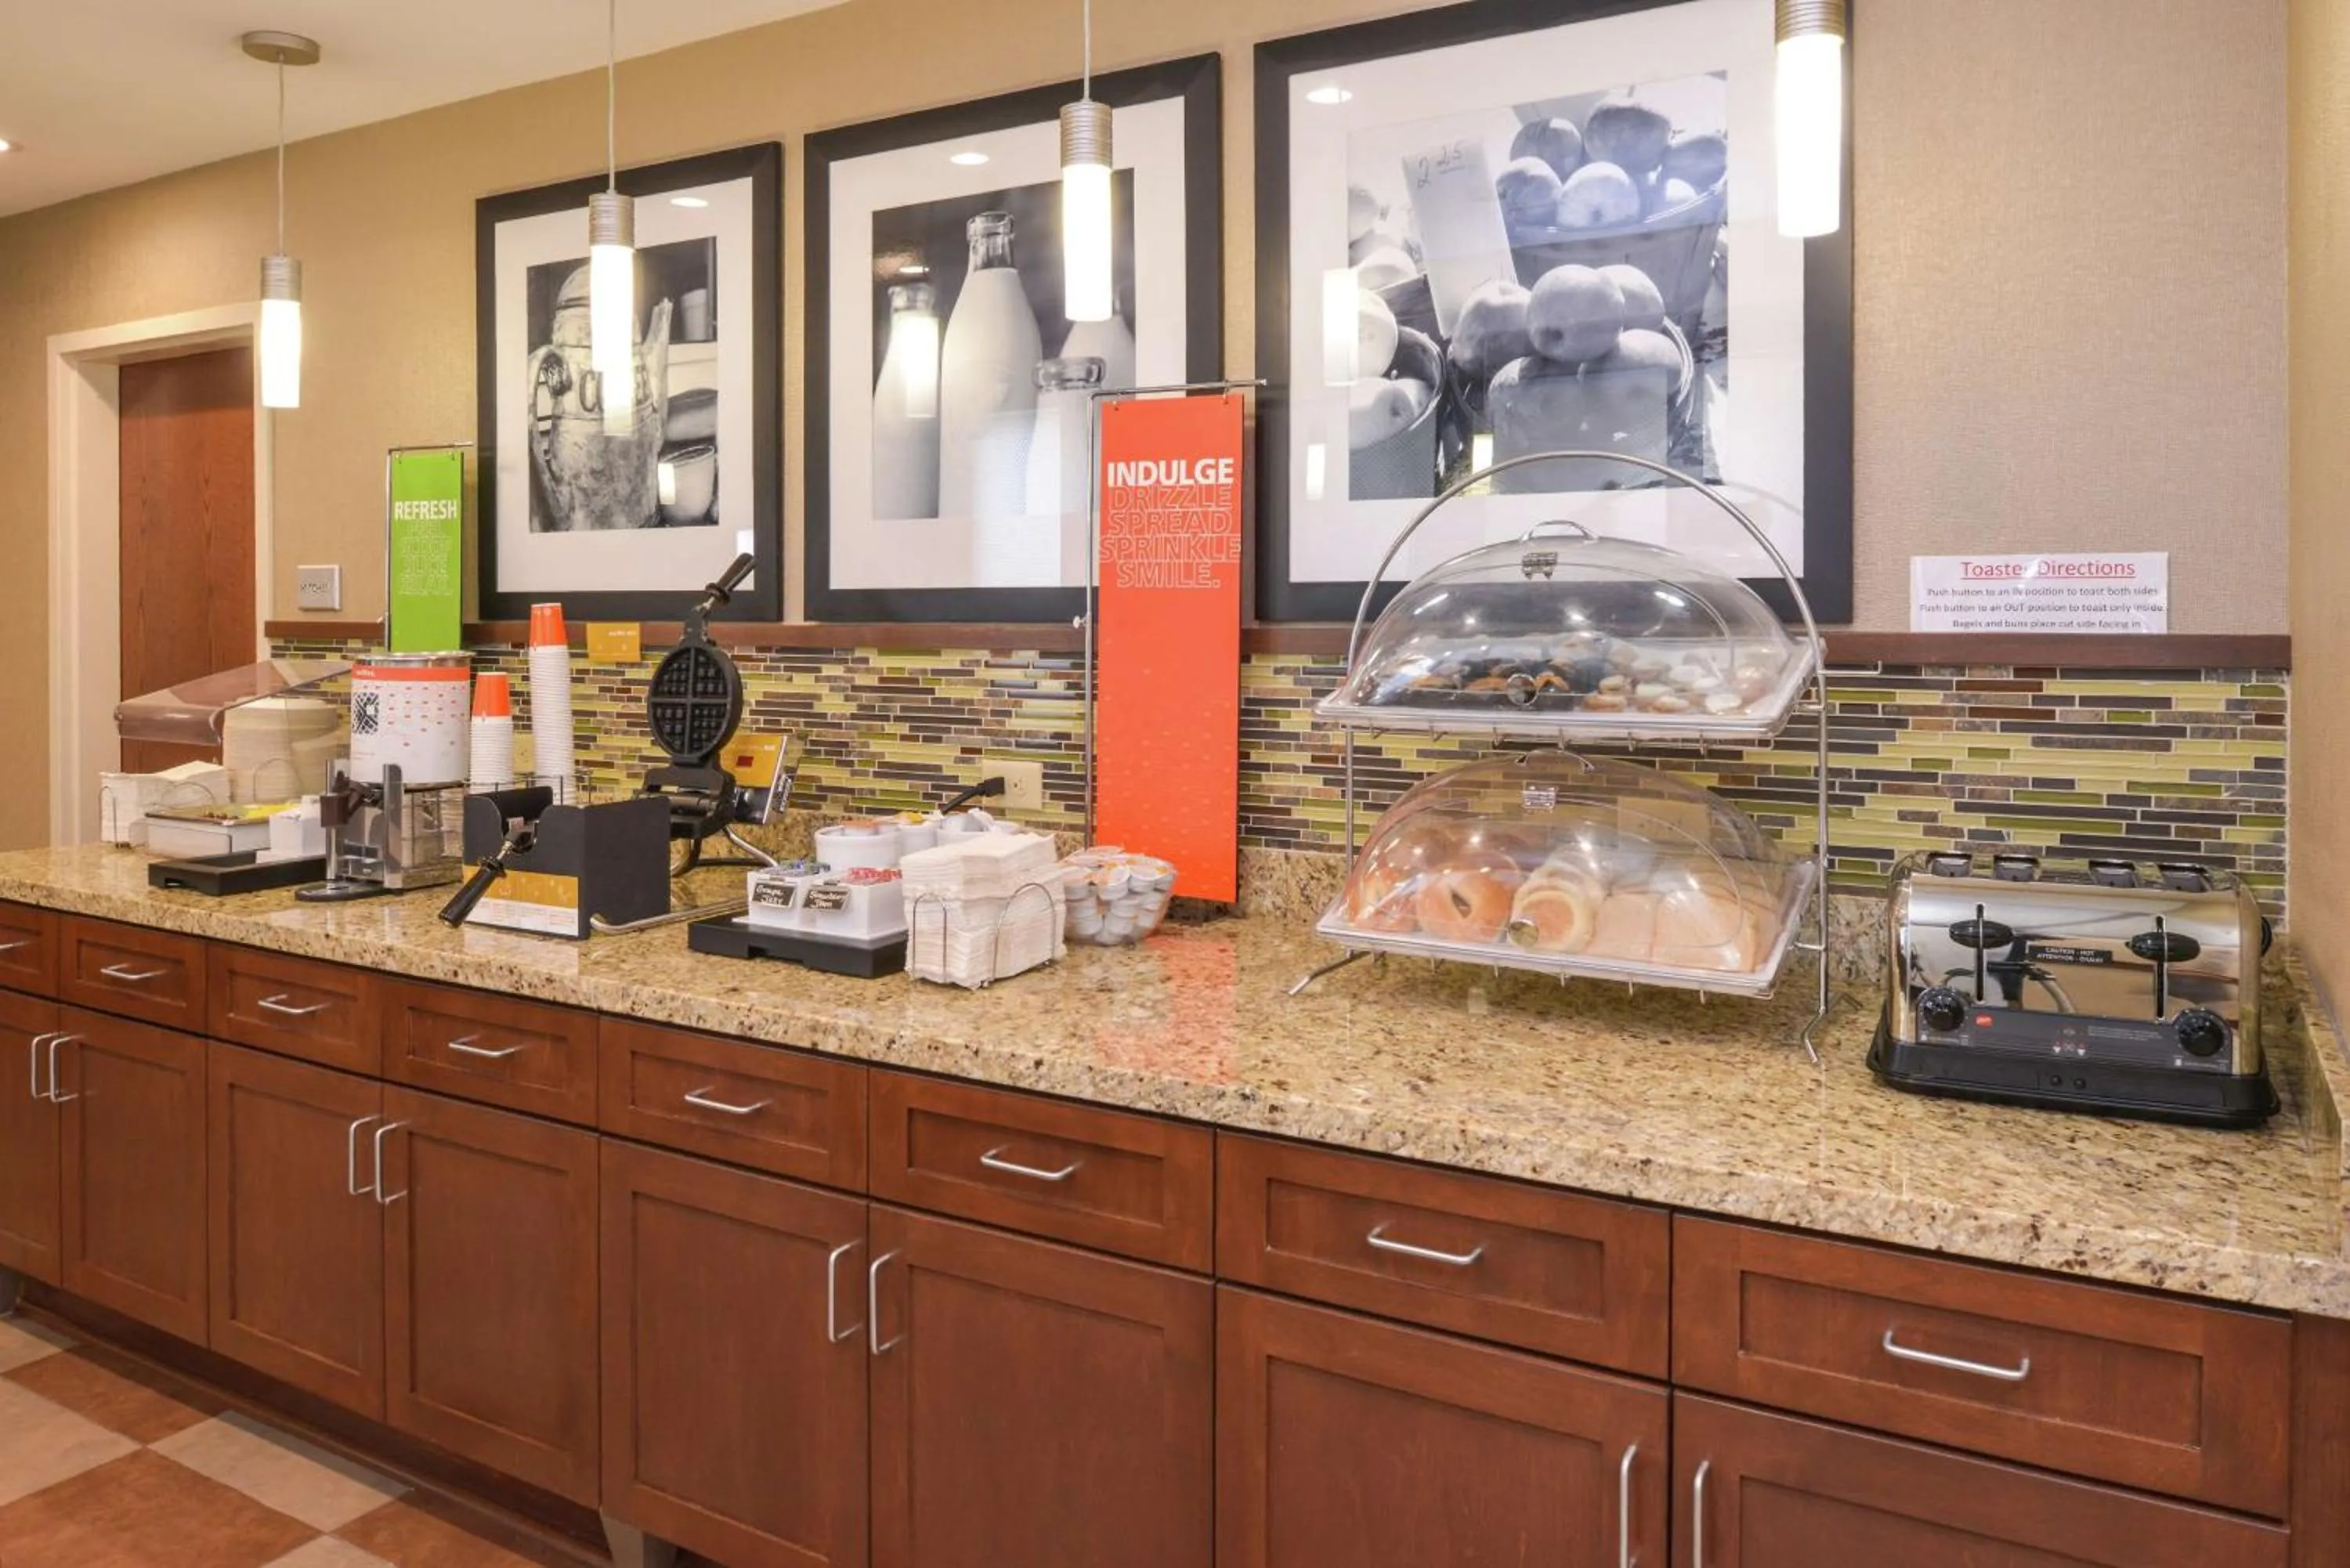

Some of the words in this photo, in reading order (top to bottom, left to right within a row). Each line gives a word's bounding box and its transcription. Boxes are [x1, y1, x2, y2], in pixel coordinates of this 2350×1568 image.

[1107, 458, 1235, 487] INDULGE
[1108, 484, 1232, 511] DRIZZLE
[394, 500, 457, 520] REFRESH
[1108, 508, 1232, 536] SPREAD
[1099, 533, 1242, 563] SPRINKLE
[1117, 560, 1221, 588] SMILE.
[2038, 559, 2136, 576] Directions
[1951, 587, 1983, 597] button
[2025, 587, 2064, 598] position
[2067, 587, 2077, 596] to
[2080, 587, 2105, 596] toast
[2107, 587, 2131, 596] both
[2133, 587, 2158, 596] sides
[1943, 604, 1976, 612] button
[2005, 603, 2025, 612] OUT
[2028, 603, 2066, 613] position
[2082, 603, 2107, 612] toast
[2110, 603, 2131, 613] only
[1953, 620, 1982, 629] Bagels
[1984, 619, 2002, 627] and
[2005, 619, 2027, 627] buns
